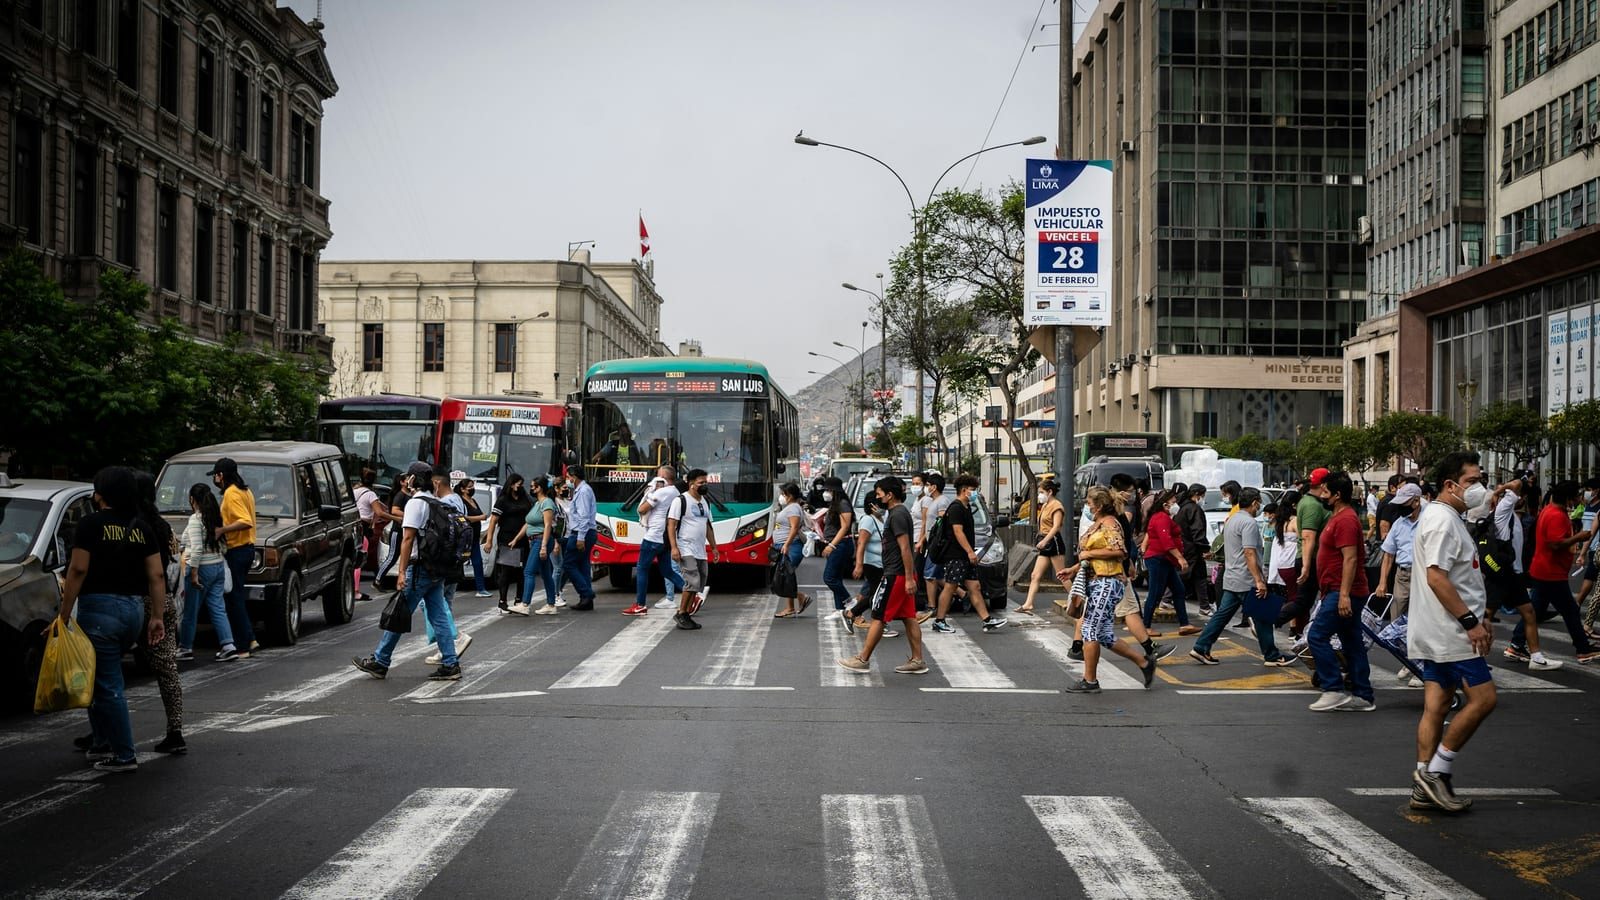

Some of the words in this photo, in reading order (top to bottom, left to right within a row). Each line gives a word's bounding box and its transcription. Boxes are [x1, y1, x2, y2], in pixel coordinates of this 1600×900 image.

[1032, 181, 1059, 190] LIMA
[1038, 207, 1100, 218] IMPUESTO
[1034, 219, 1104, 230] VEHICULAR
[1046, 232, 1078, 242] VENCE
[1082, 232, 1092, 242] EL
[1052, 247, 1084, 269] 28
[1041, 276, 1053, 285] DE
[1055, 276, 1095, 285] FEBRERO
[1265, 364, 1343, 374] MINISTERIO
[1291, 375, 1322, 383] SEDE
[587, 379, 628, 393] CARABAYLLO
[633, 381, 651, 391] KM
[653, 381, 667, 391] 22
[676, 381, 716, 391] COMAS
[722, 379, 741, 391] SAN
[743, 380, 763, 392] LUIS
[458, 422, 495, 433] MEXICO
[509, 424, 547, 437] ABANCAY
[477, 435, 496, 453] 49
[103, 525, 146, 545] NIRVNA
[1097, 577, 1111, 610] UNDER
[1089, 612, 1100, 641] ARMOU
